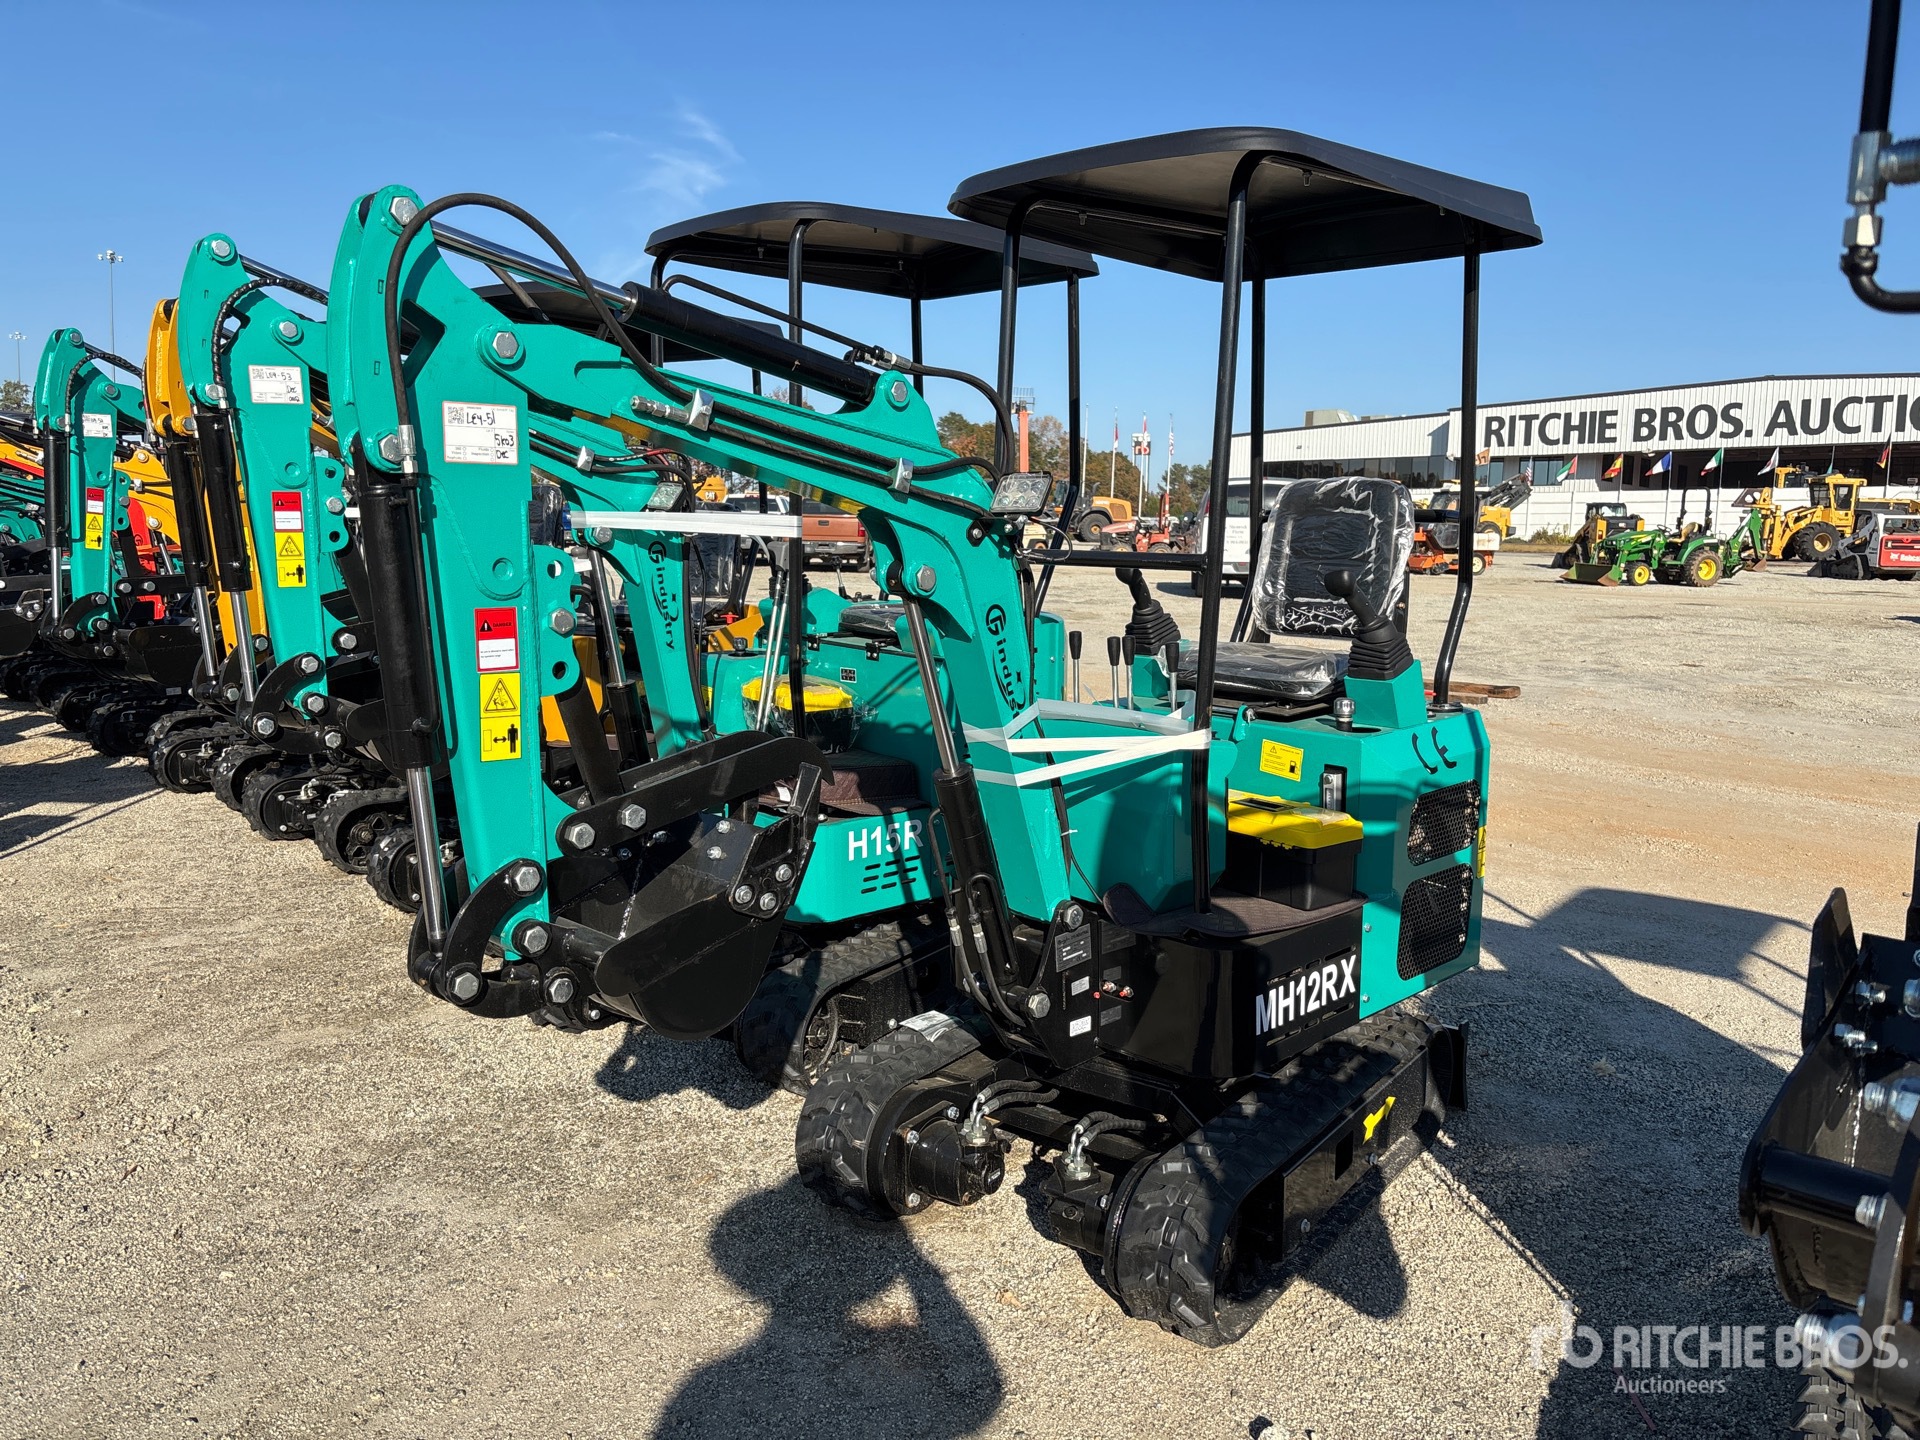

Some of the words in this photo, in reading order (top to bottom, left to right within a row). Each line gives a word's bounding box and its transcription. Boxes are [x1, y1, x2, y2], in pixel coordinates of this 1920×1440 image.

[1484, 410, 1617, 447] RITCHIE
[1633, 402, 1752, 442] BROS.
[705, 491, 715, 500] CAT
[1411, 726, 1458, 775] CE
[848, 819, 923, 861] H15R
[1255, 954, 1357, 1036] MH12RX
